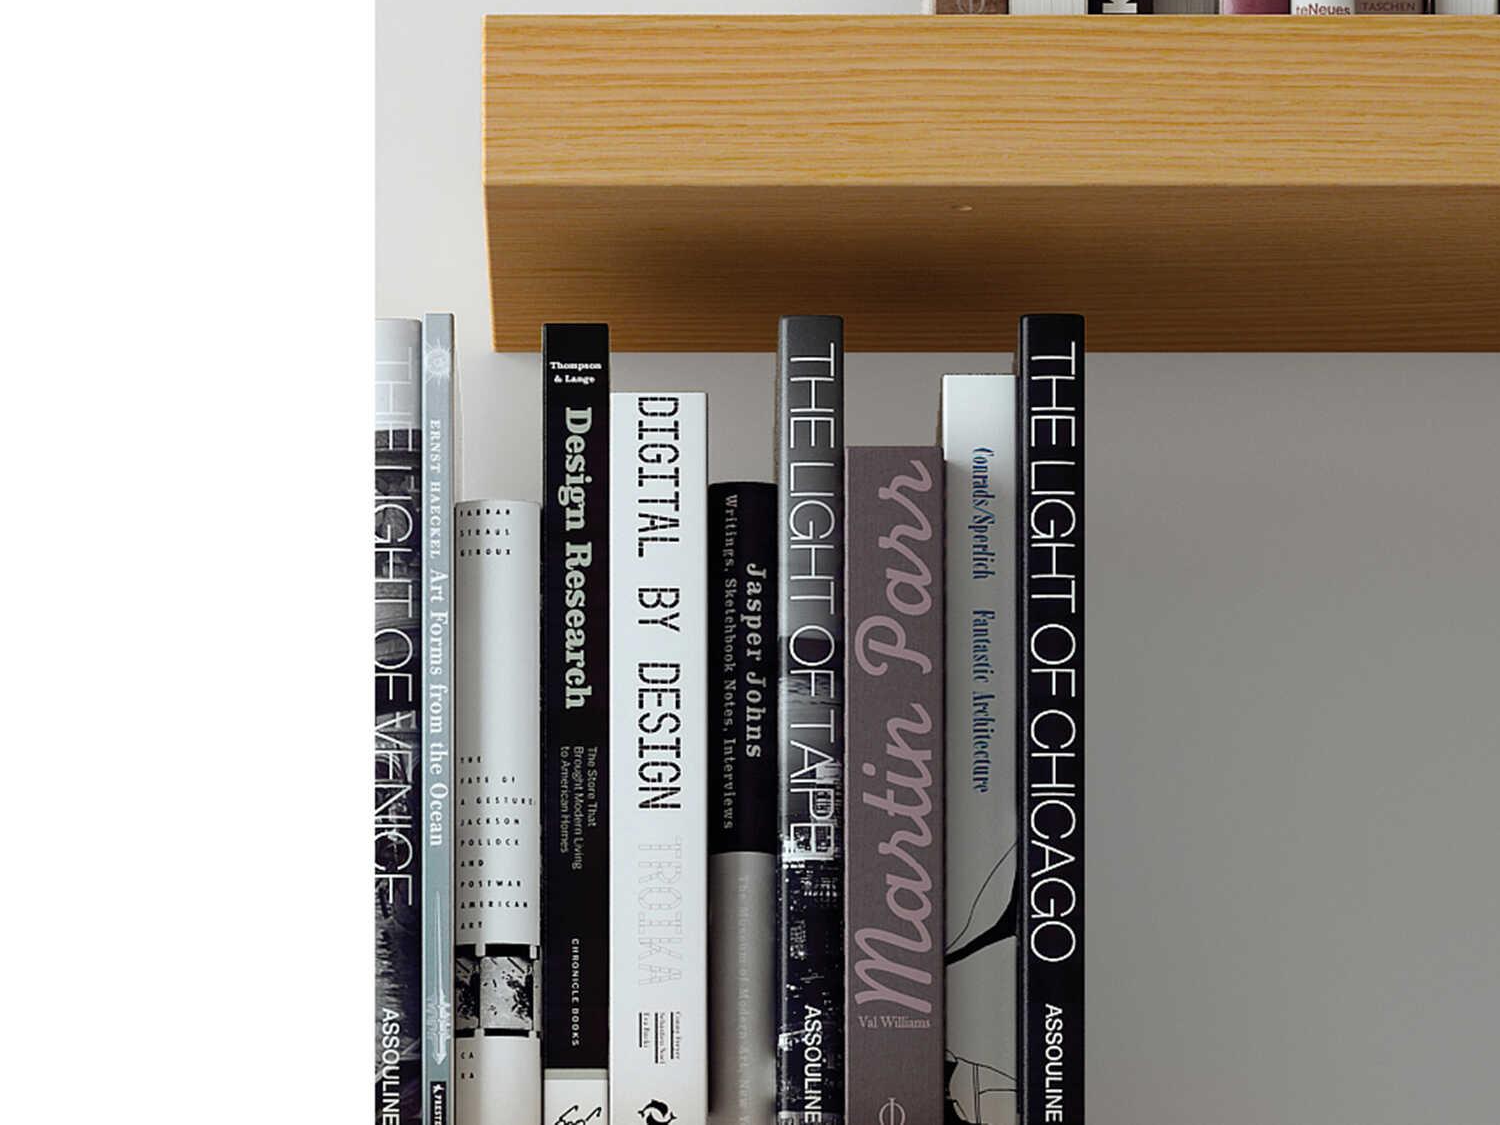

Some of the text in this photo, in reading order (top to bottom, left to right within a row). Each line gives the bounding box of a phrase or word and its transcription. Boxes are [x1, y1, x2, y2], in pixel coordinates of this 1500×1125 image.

[1360, 1, 1417, 12] TASCHEN
[550, 362, 601, 371] Thompson
[565, 375, 595, 384] Lange
[375, 345, 413, 906] THE LIGHT OF VENICE
[430, 420, 450, 845] ERNST HAECKEL Art Forms from the Ocean
[558, 407, 592, 709] Design Research
[638, 397, 680, 808] DIGITAL BY DESIGN
[789, 342, 835, 860] THE LIGHT OF TAIPEI
[968, 446, 996, 792] Conrads/Sperlich Fantastic Architecture
[723, 495, 737, 828] Writings, Sketchbook Notes, Interviews
[741, 563, 766, 757] Jasper Johns
[1031, 342, 1076, 962] THE LIGHT OF CHICAGO
[560, 746, 570, 853] to American Homes
[572, 746, 584, 869] Brought Modern Living
[588, 746, 598, 826] The Store That
[854, 459, 933, 1014] Martin Parr
[638, 834, 682, 987] TROIKA
[382, 1007, 400, 1125] ASSOULINE
[804, 1004, 822, 1124] ASSOULINE
[858, 1015, 930, 1028] Val Williams
[1046, 1004, 1063, 1122] ASSOULINE
